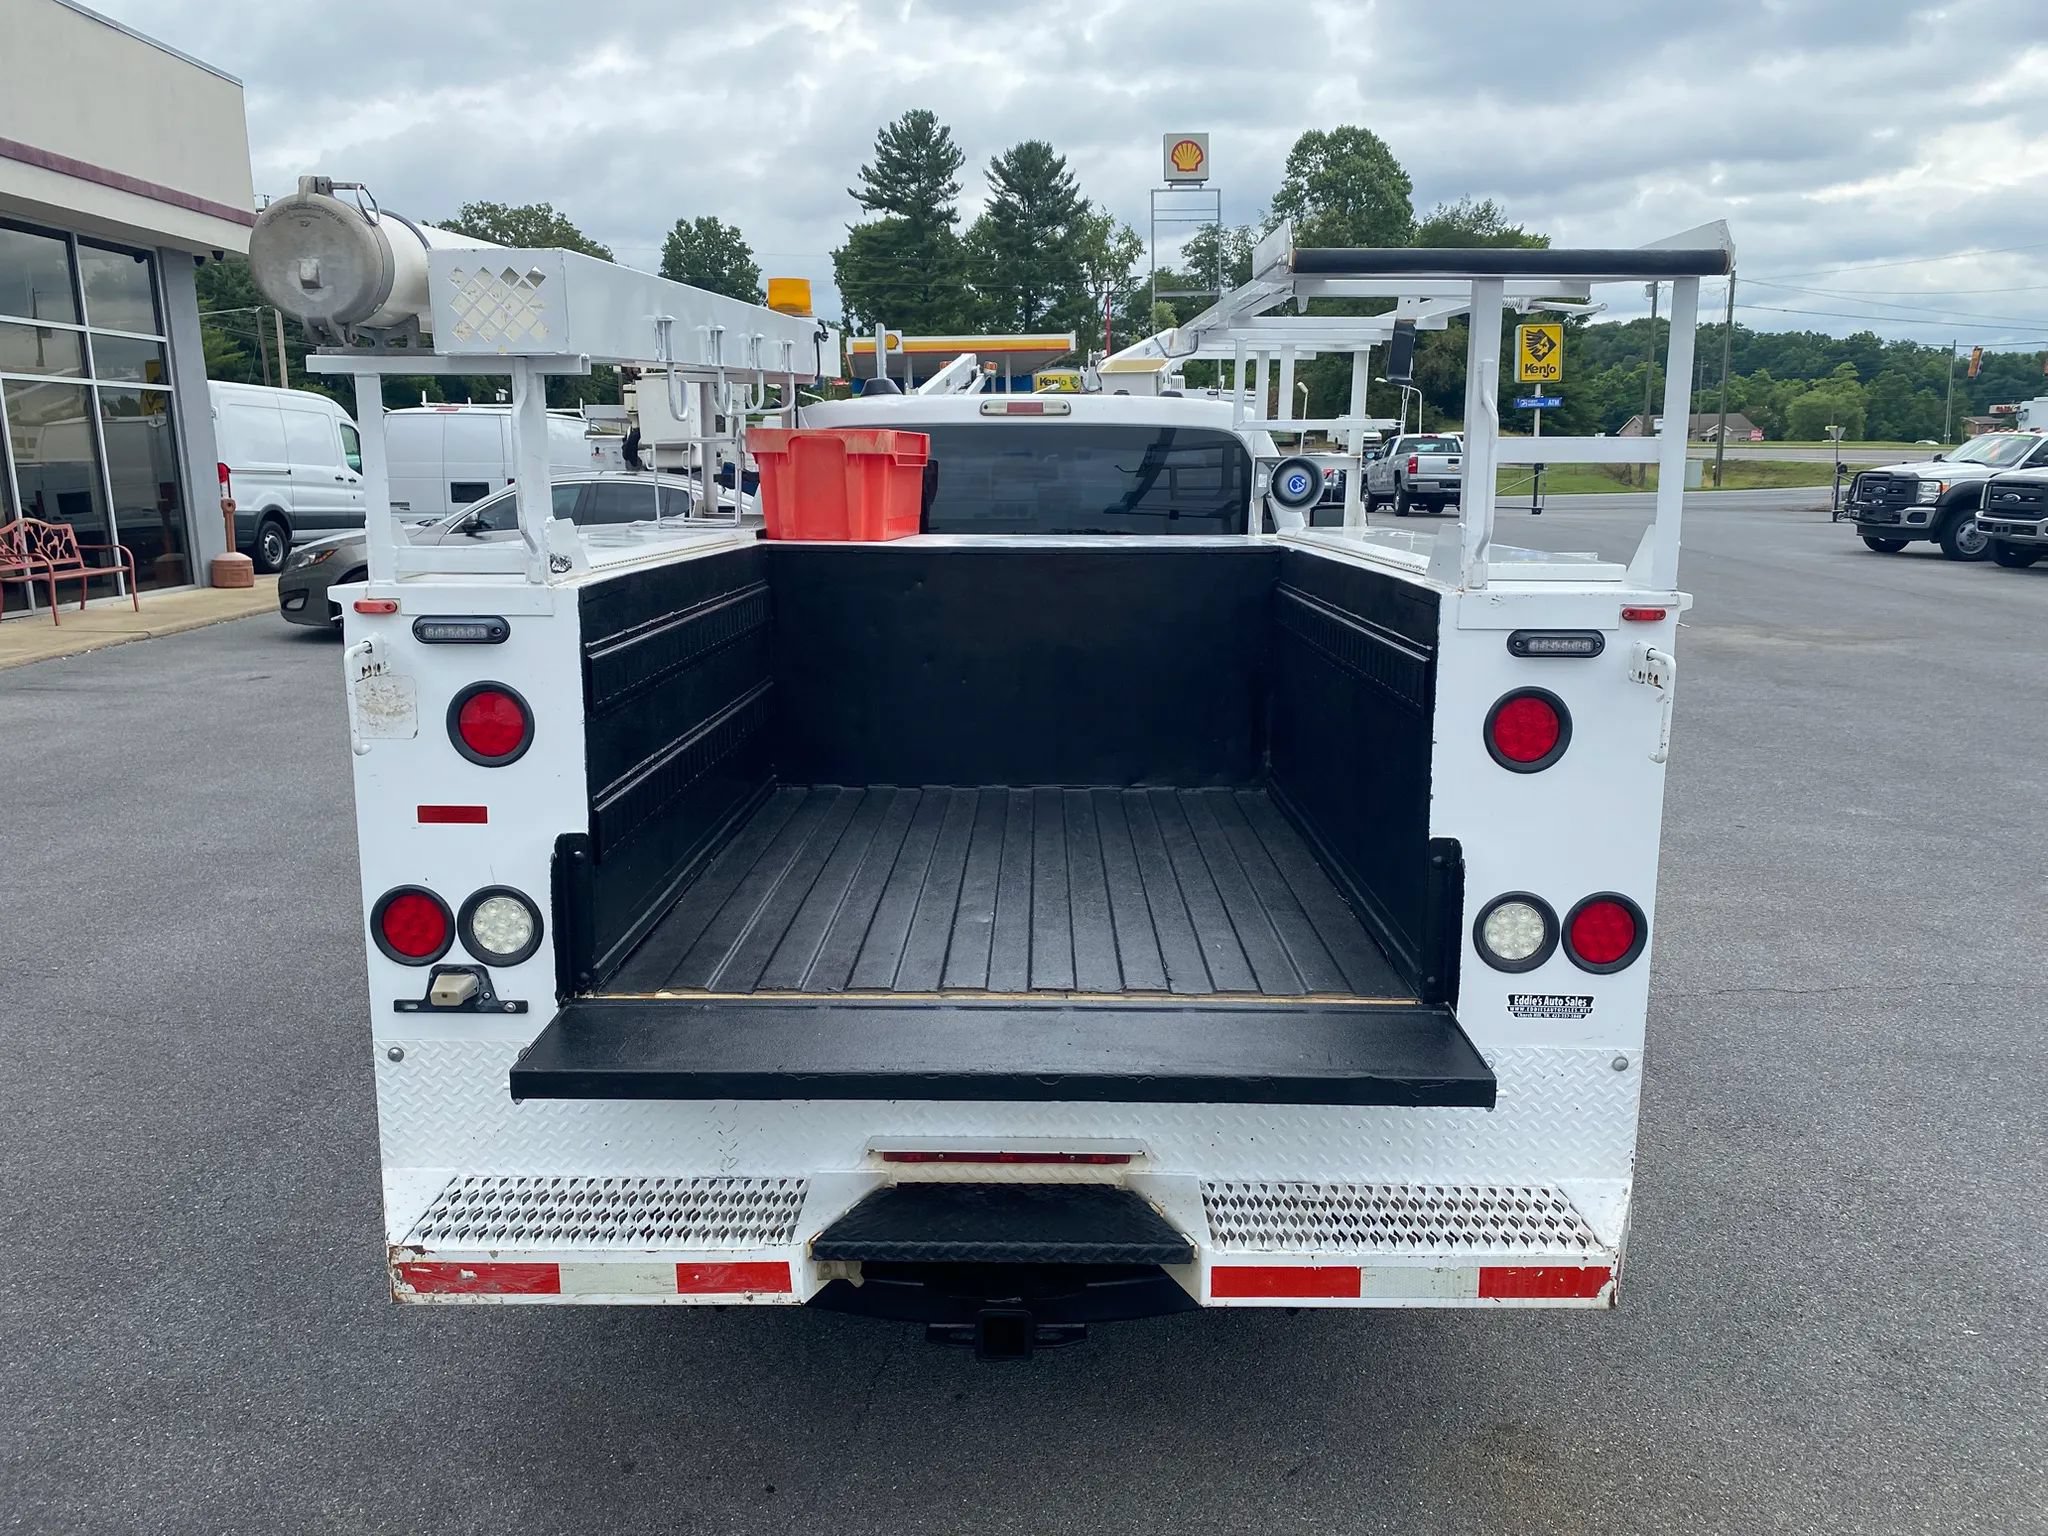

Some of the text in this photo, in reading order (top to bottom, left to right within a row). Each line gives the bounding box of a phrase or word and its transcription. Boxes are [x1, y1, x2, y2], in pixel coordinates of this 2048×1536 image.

[1514, 995, 1587, 1007] Eddie's Auto Sales
